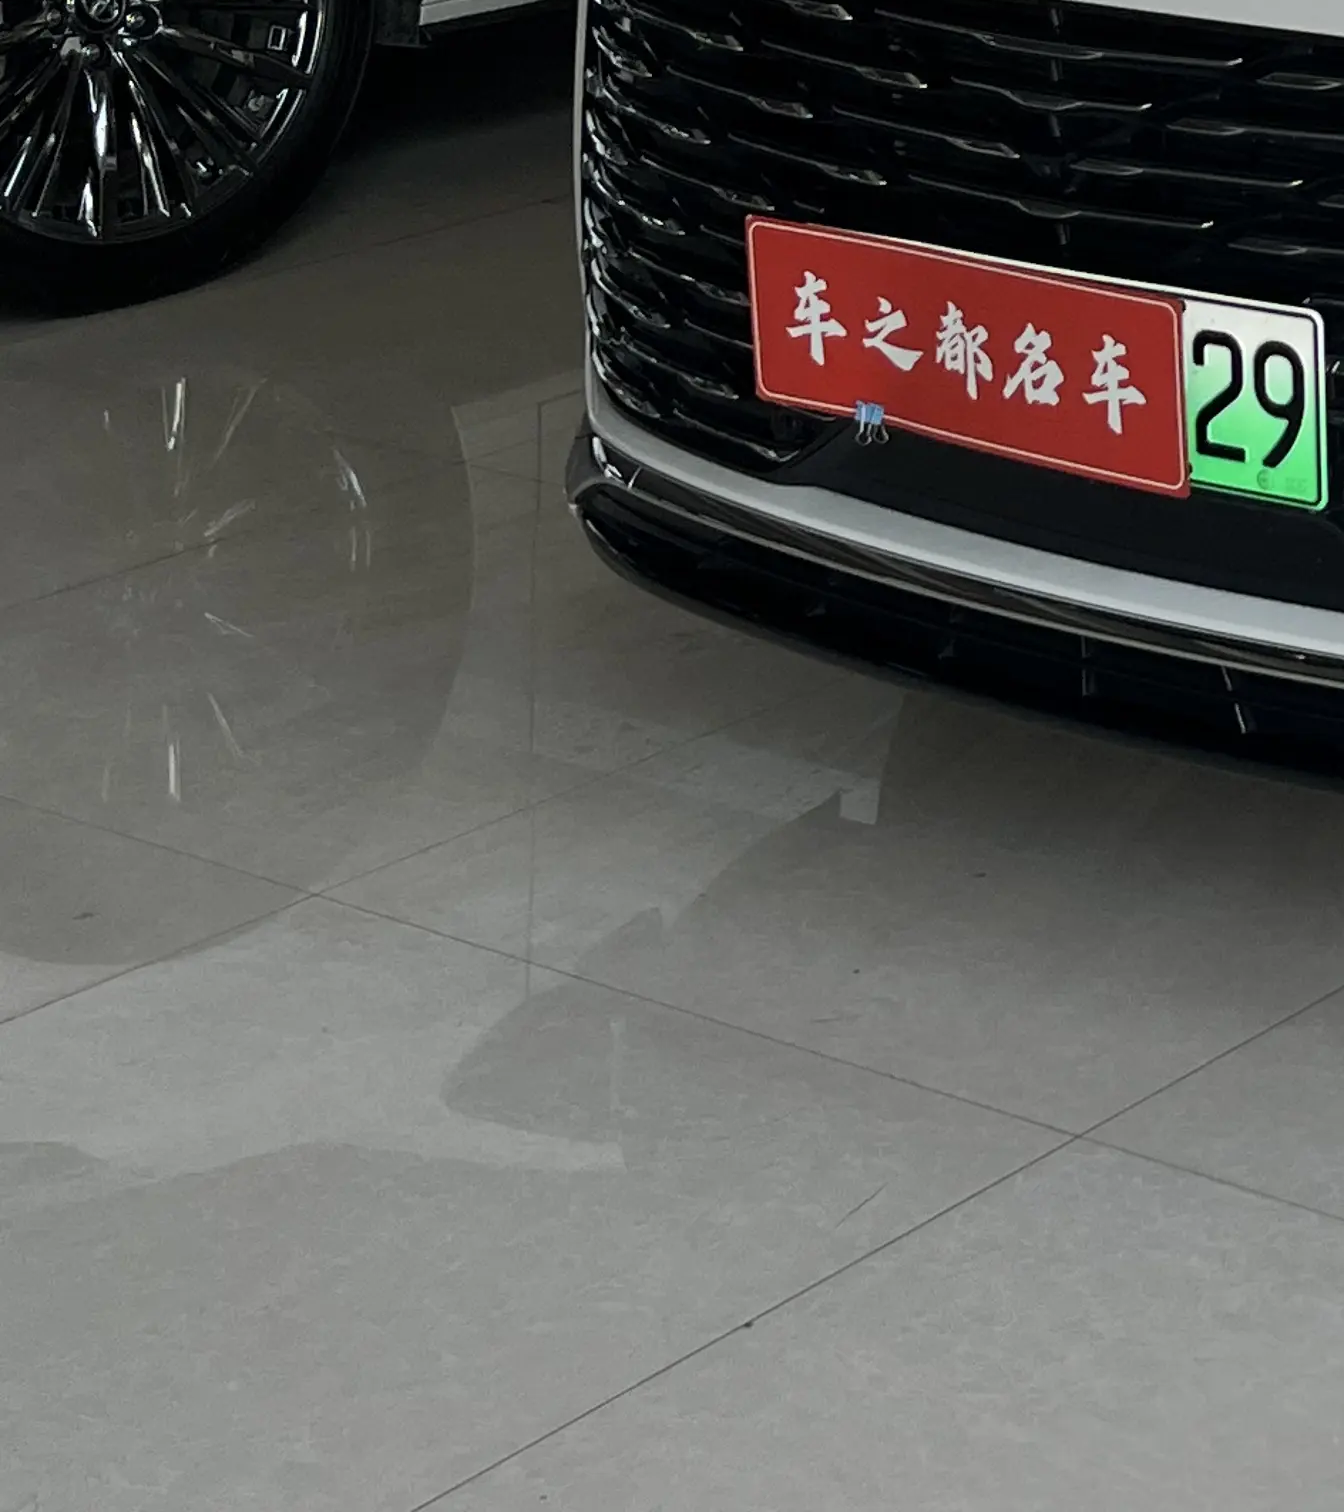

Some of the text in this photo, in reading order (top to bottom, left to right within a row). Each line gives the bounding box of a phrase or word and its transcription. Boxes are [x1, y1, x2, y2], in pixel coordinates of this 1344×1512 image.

[785, 269, 1146, 435] 车之都名车
[1191, 329, 1306, 469] 29
